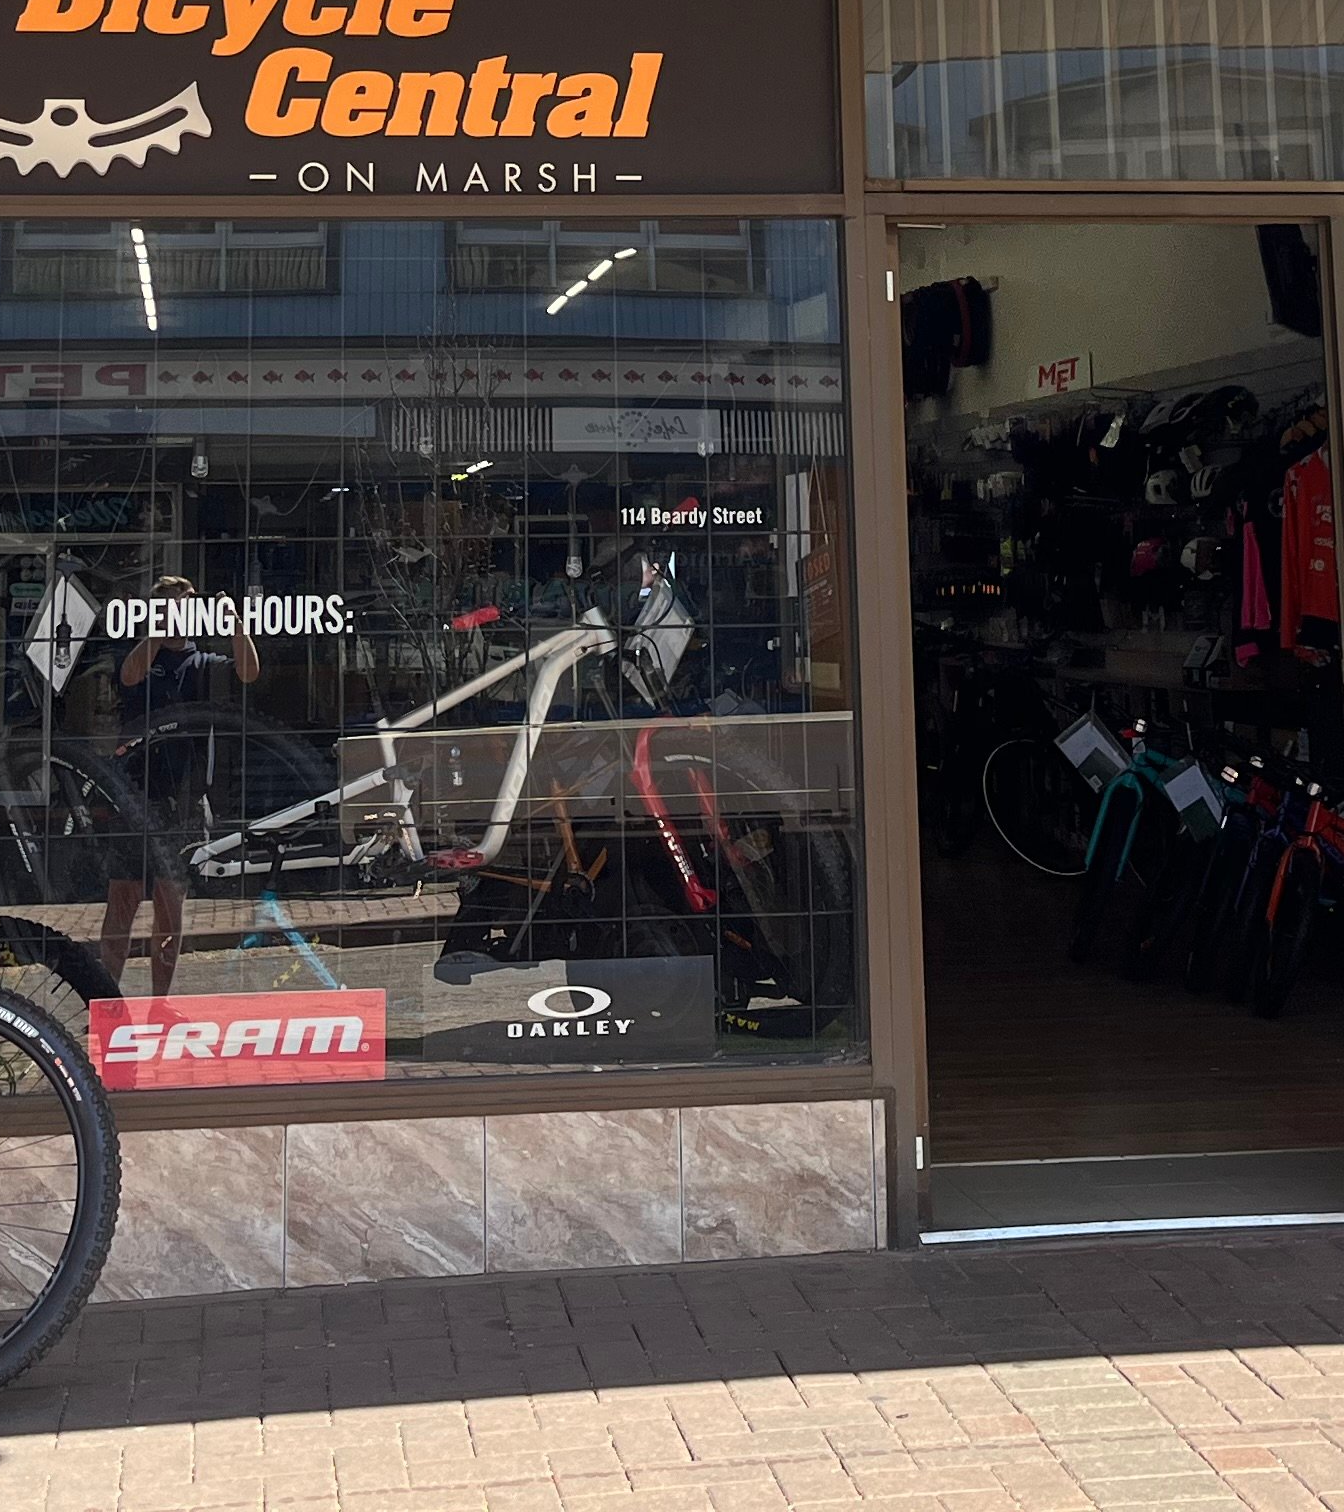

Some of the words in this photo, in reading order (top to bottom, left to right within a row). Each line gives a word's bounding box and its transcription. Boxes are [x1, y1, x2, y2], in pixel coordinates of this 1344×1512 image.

[243, 47, 663, 139] Central
[297, 162, 376, 194] ON
[415, 162, 598, 194] MARSH
[1038, 357, 1080, 392] MET
[621, 508, 646, 526] 114
[651, 507, 707, 528] Beardy
[712, 507, 763, 525] Street
[106, 597, 235, 638] OPENING
[243, 595, 354, 636] HOURS:
[104, 1016, 364, 1064] SRAM
[507, 1019, 630, 1039] OAKLEY
